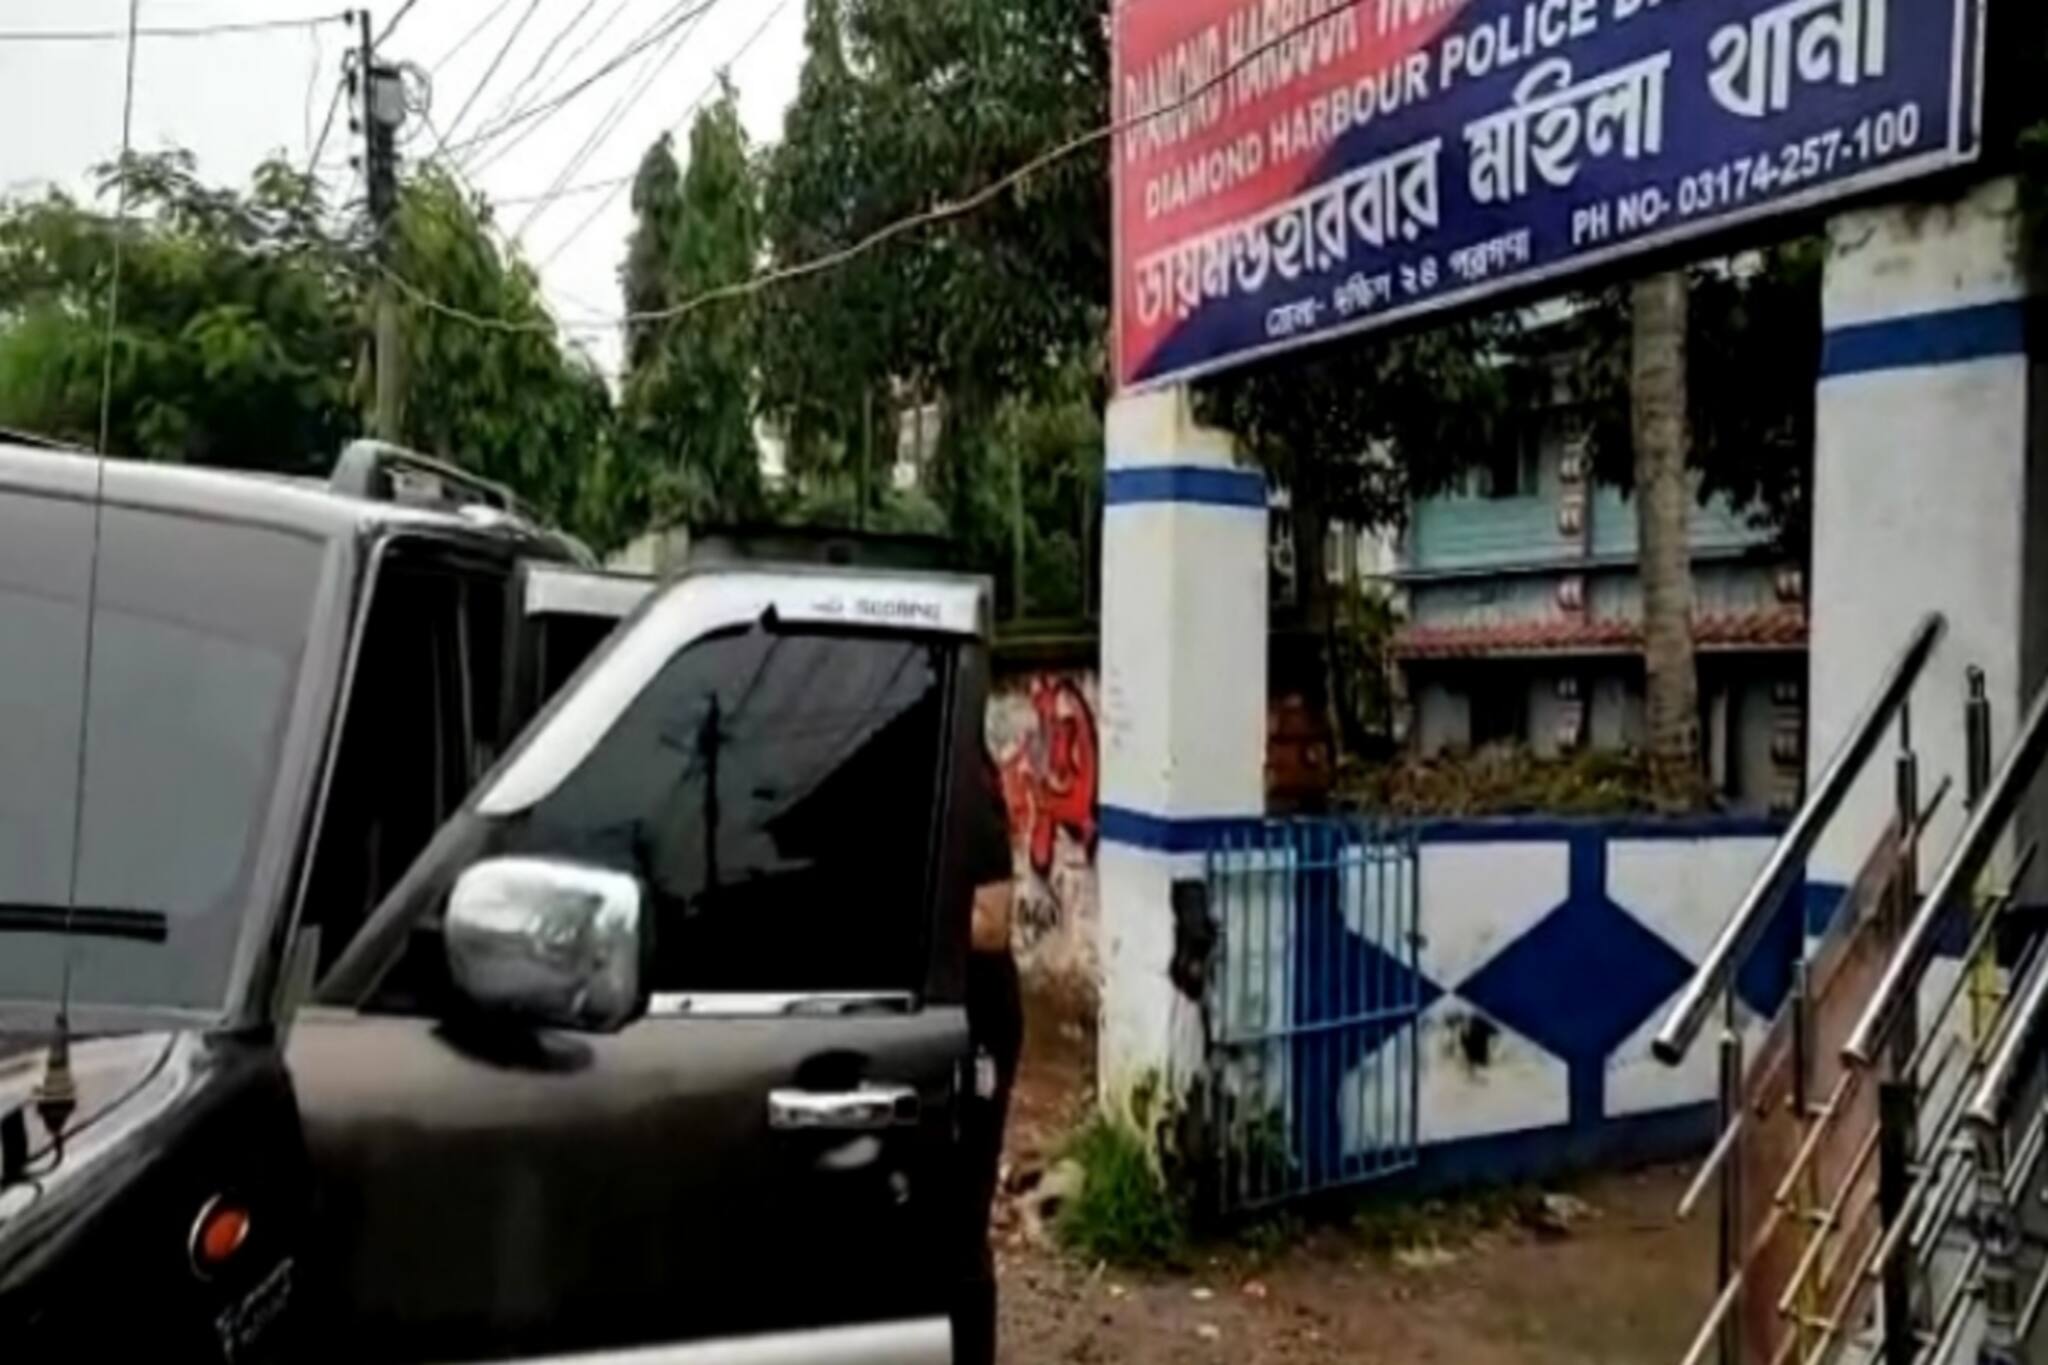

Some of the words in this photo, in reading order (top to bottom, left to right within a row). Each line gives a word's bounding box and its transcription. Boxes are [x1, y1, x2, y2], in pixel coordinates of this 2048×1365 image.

[1145, 132, 1263, 219] DIAMOND
[1269, 51, 1430, 164] HARBOUR
[1439, 0, 1598, 89] POLICE
[1463, 50, 1671, 204] মহিলা
[1707, 0, 1886, 117] থানা
[1573, 201, 1609, 245] PH
[1617, 187, 1670, 233] NO-
[1678, 102, 1919, 215] 03174-257-100
[1400, 255, 1439, 294] ২৪
